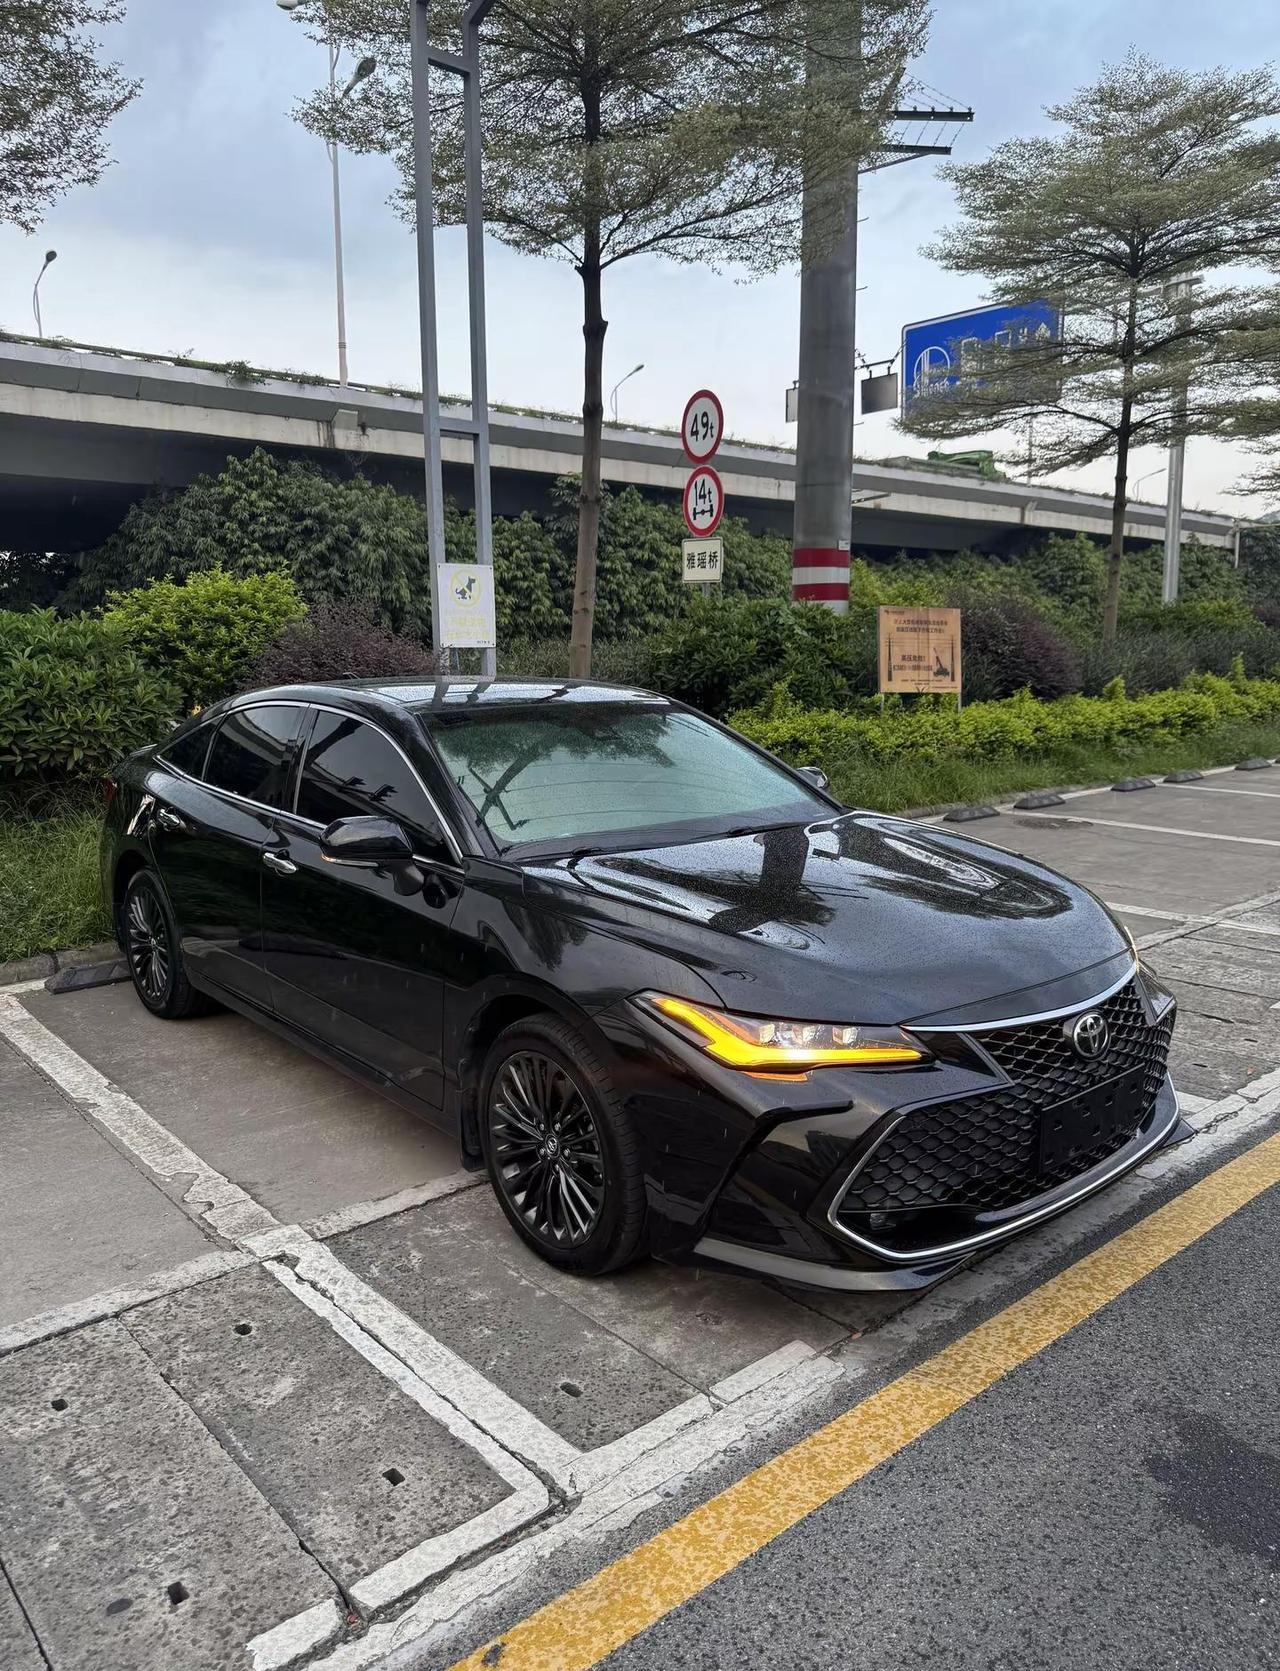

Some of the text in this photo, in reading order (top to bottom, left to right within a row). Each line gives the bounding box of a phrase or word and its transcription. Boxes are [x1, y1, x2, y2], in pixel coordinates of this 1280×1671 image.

[690, 411, 714, 442] 49t
[694, 478, 713, 507] 14t
[686, 551, 718, 569] 雅瑶桥
